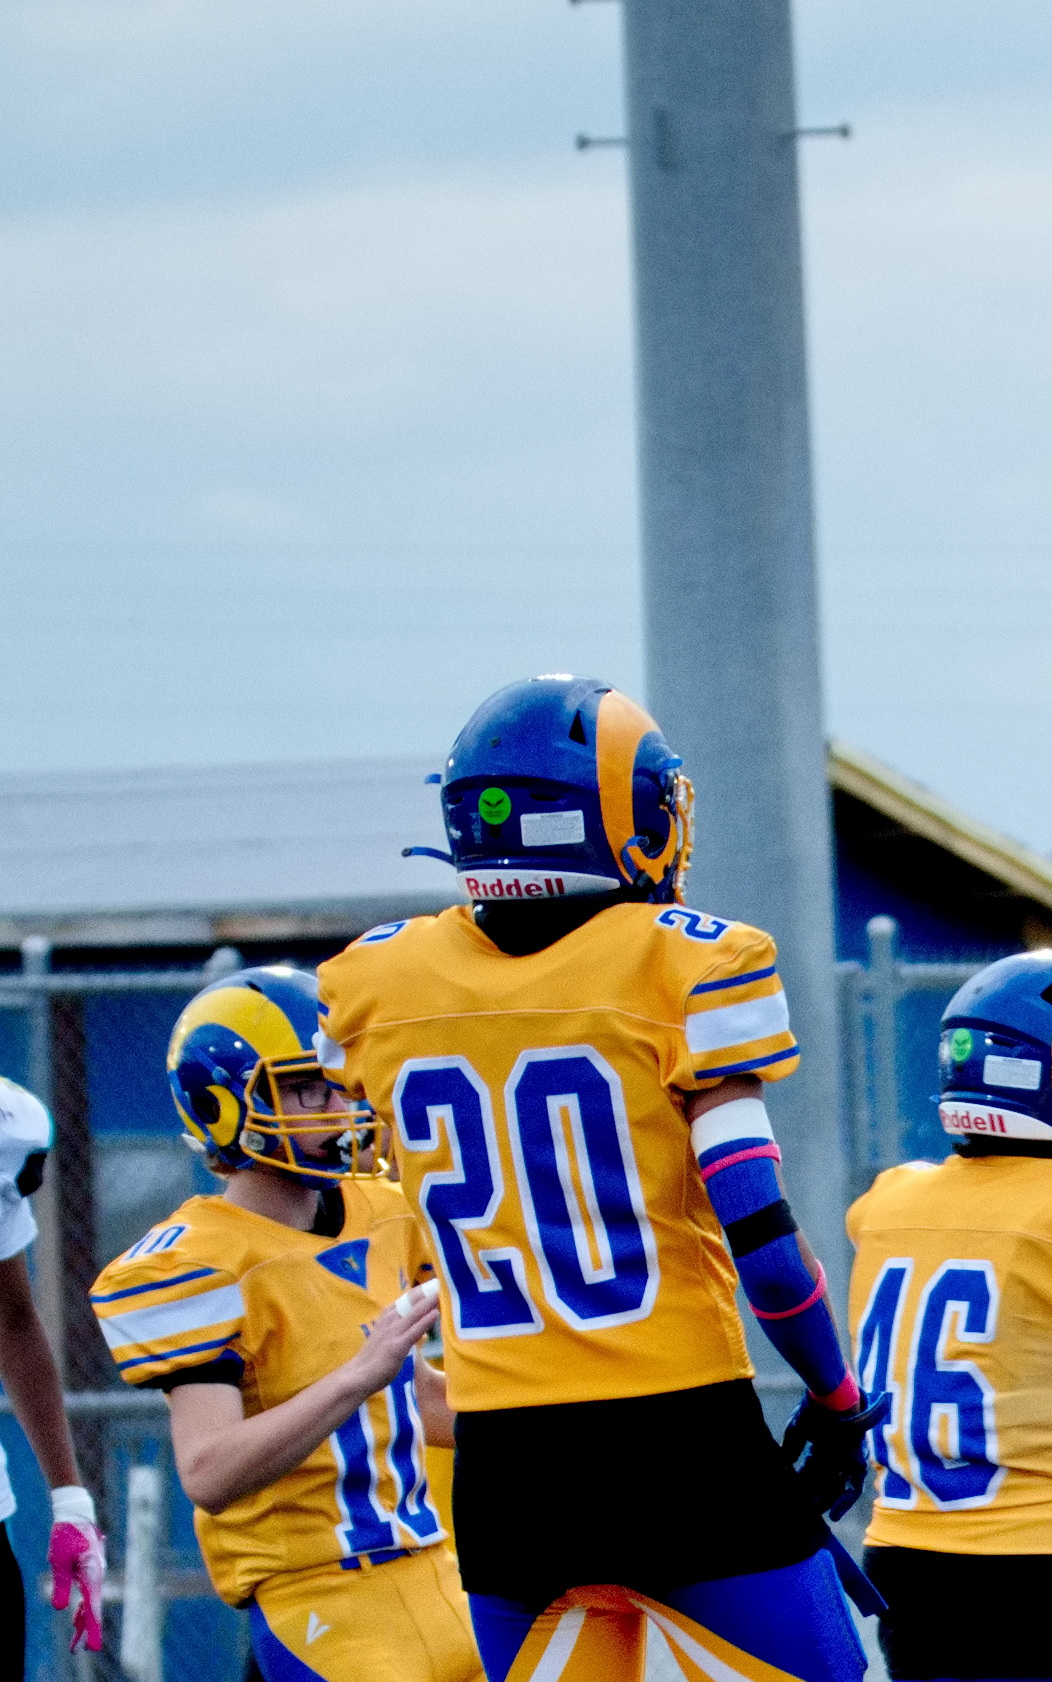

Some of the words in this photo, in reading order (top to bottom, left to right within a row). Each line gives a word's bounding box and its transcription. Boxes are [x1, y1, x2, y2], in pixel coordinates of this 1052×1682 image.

[465, 877, 565, 898] Riddell
[392, 1044, 660, 1340] 20
[855, 1257, 1008, 1511] 46
